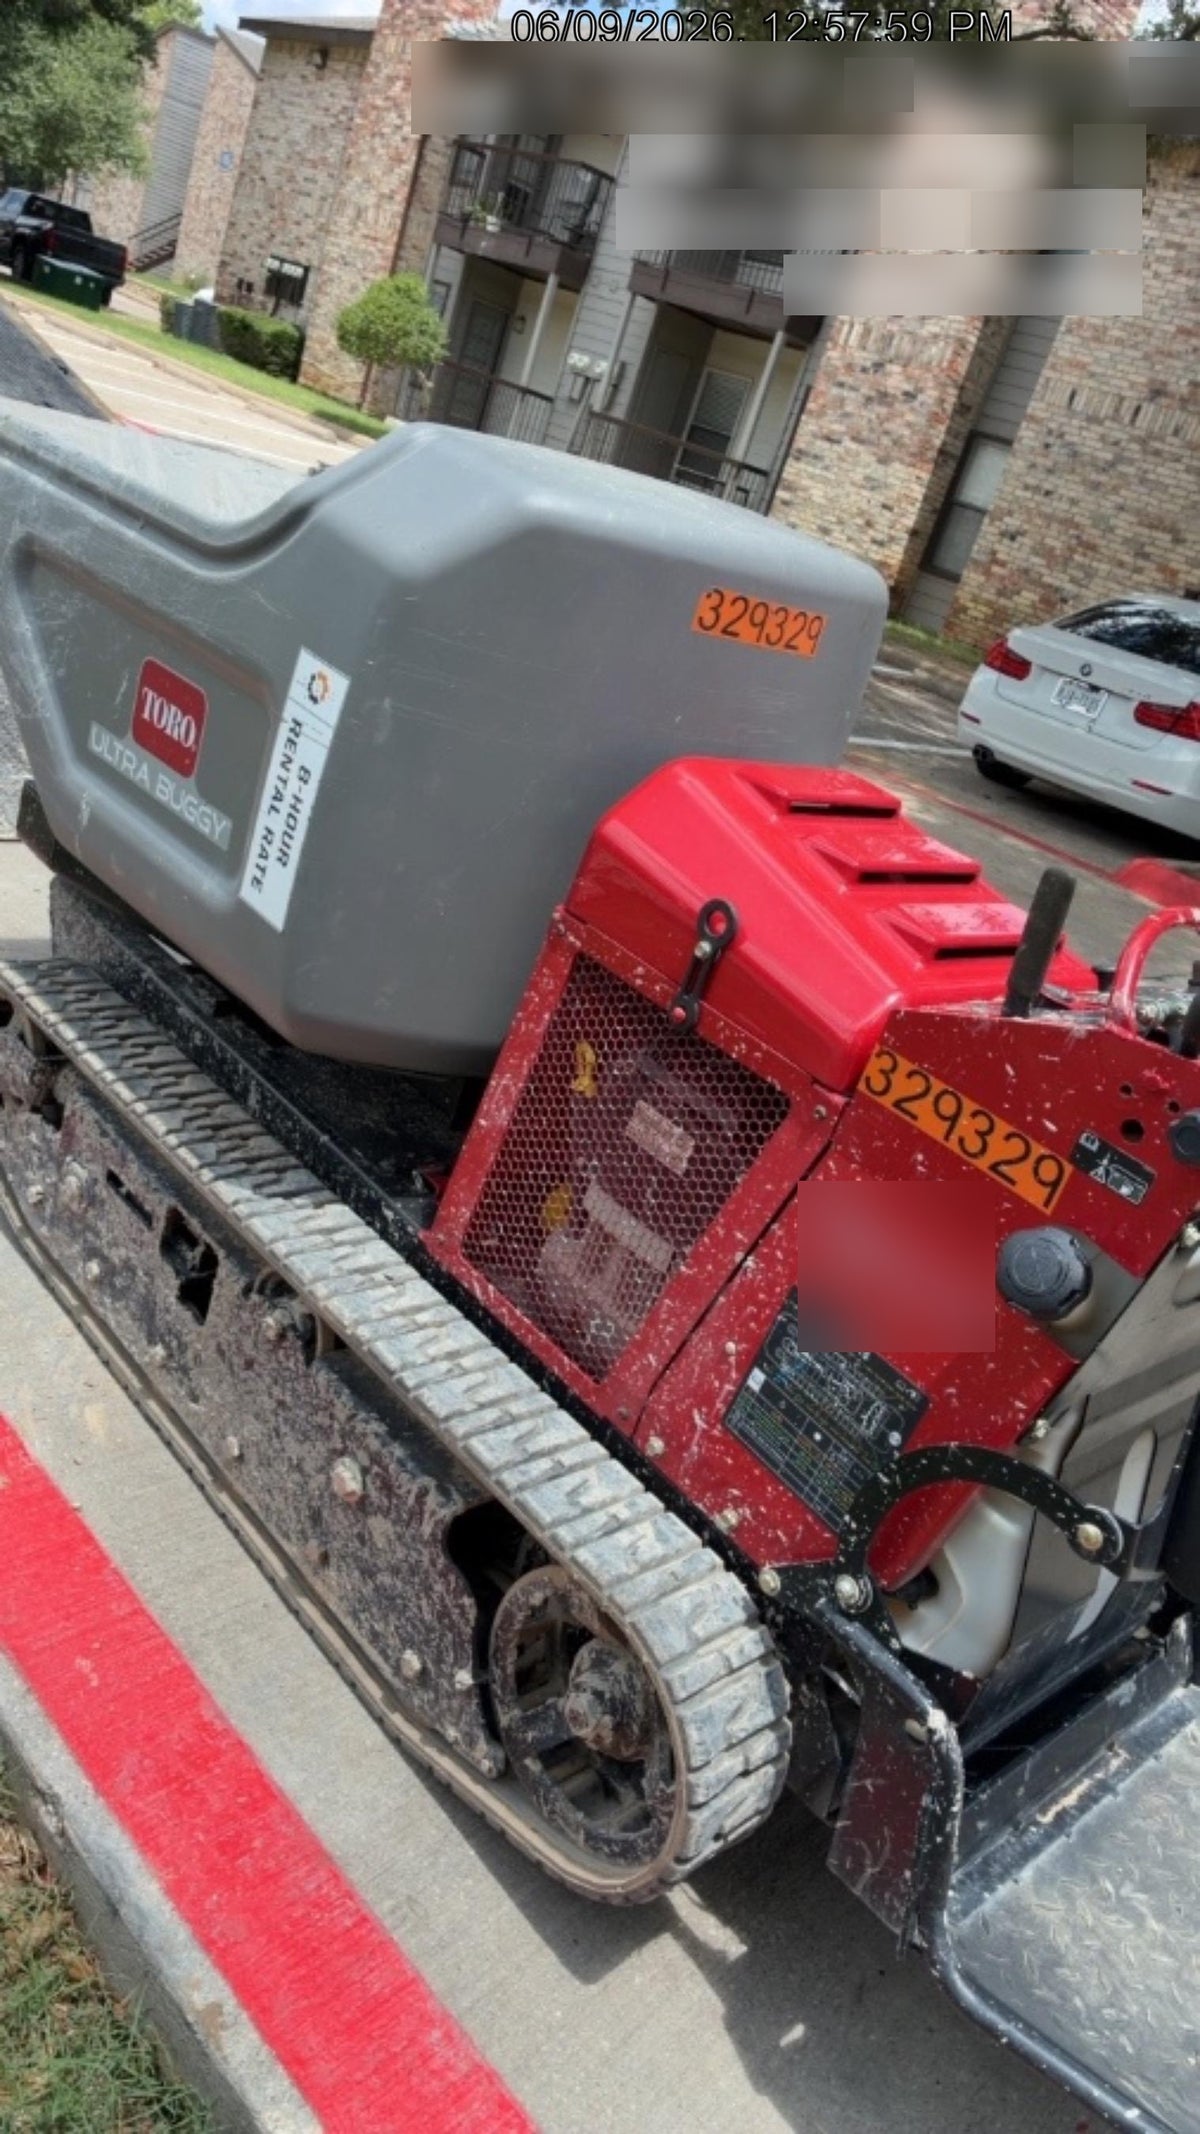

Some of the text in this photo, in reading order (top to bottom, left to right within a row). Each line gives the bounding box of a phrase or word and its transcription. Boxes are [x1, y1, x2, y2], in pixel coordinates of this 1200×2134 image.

[698, 588, 823, 655] 329329
[141, 687, 197, 748] TORO
[91, 726, 227, 841] ULTRA BUGGY
[250, 717, 303, 895] RENTAL RATE
[276, 764, 312, 869] 8-HOUR
[865, 1049, 1065, 1210] 329329
